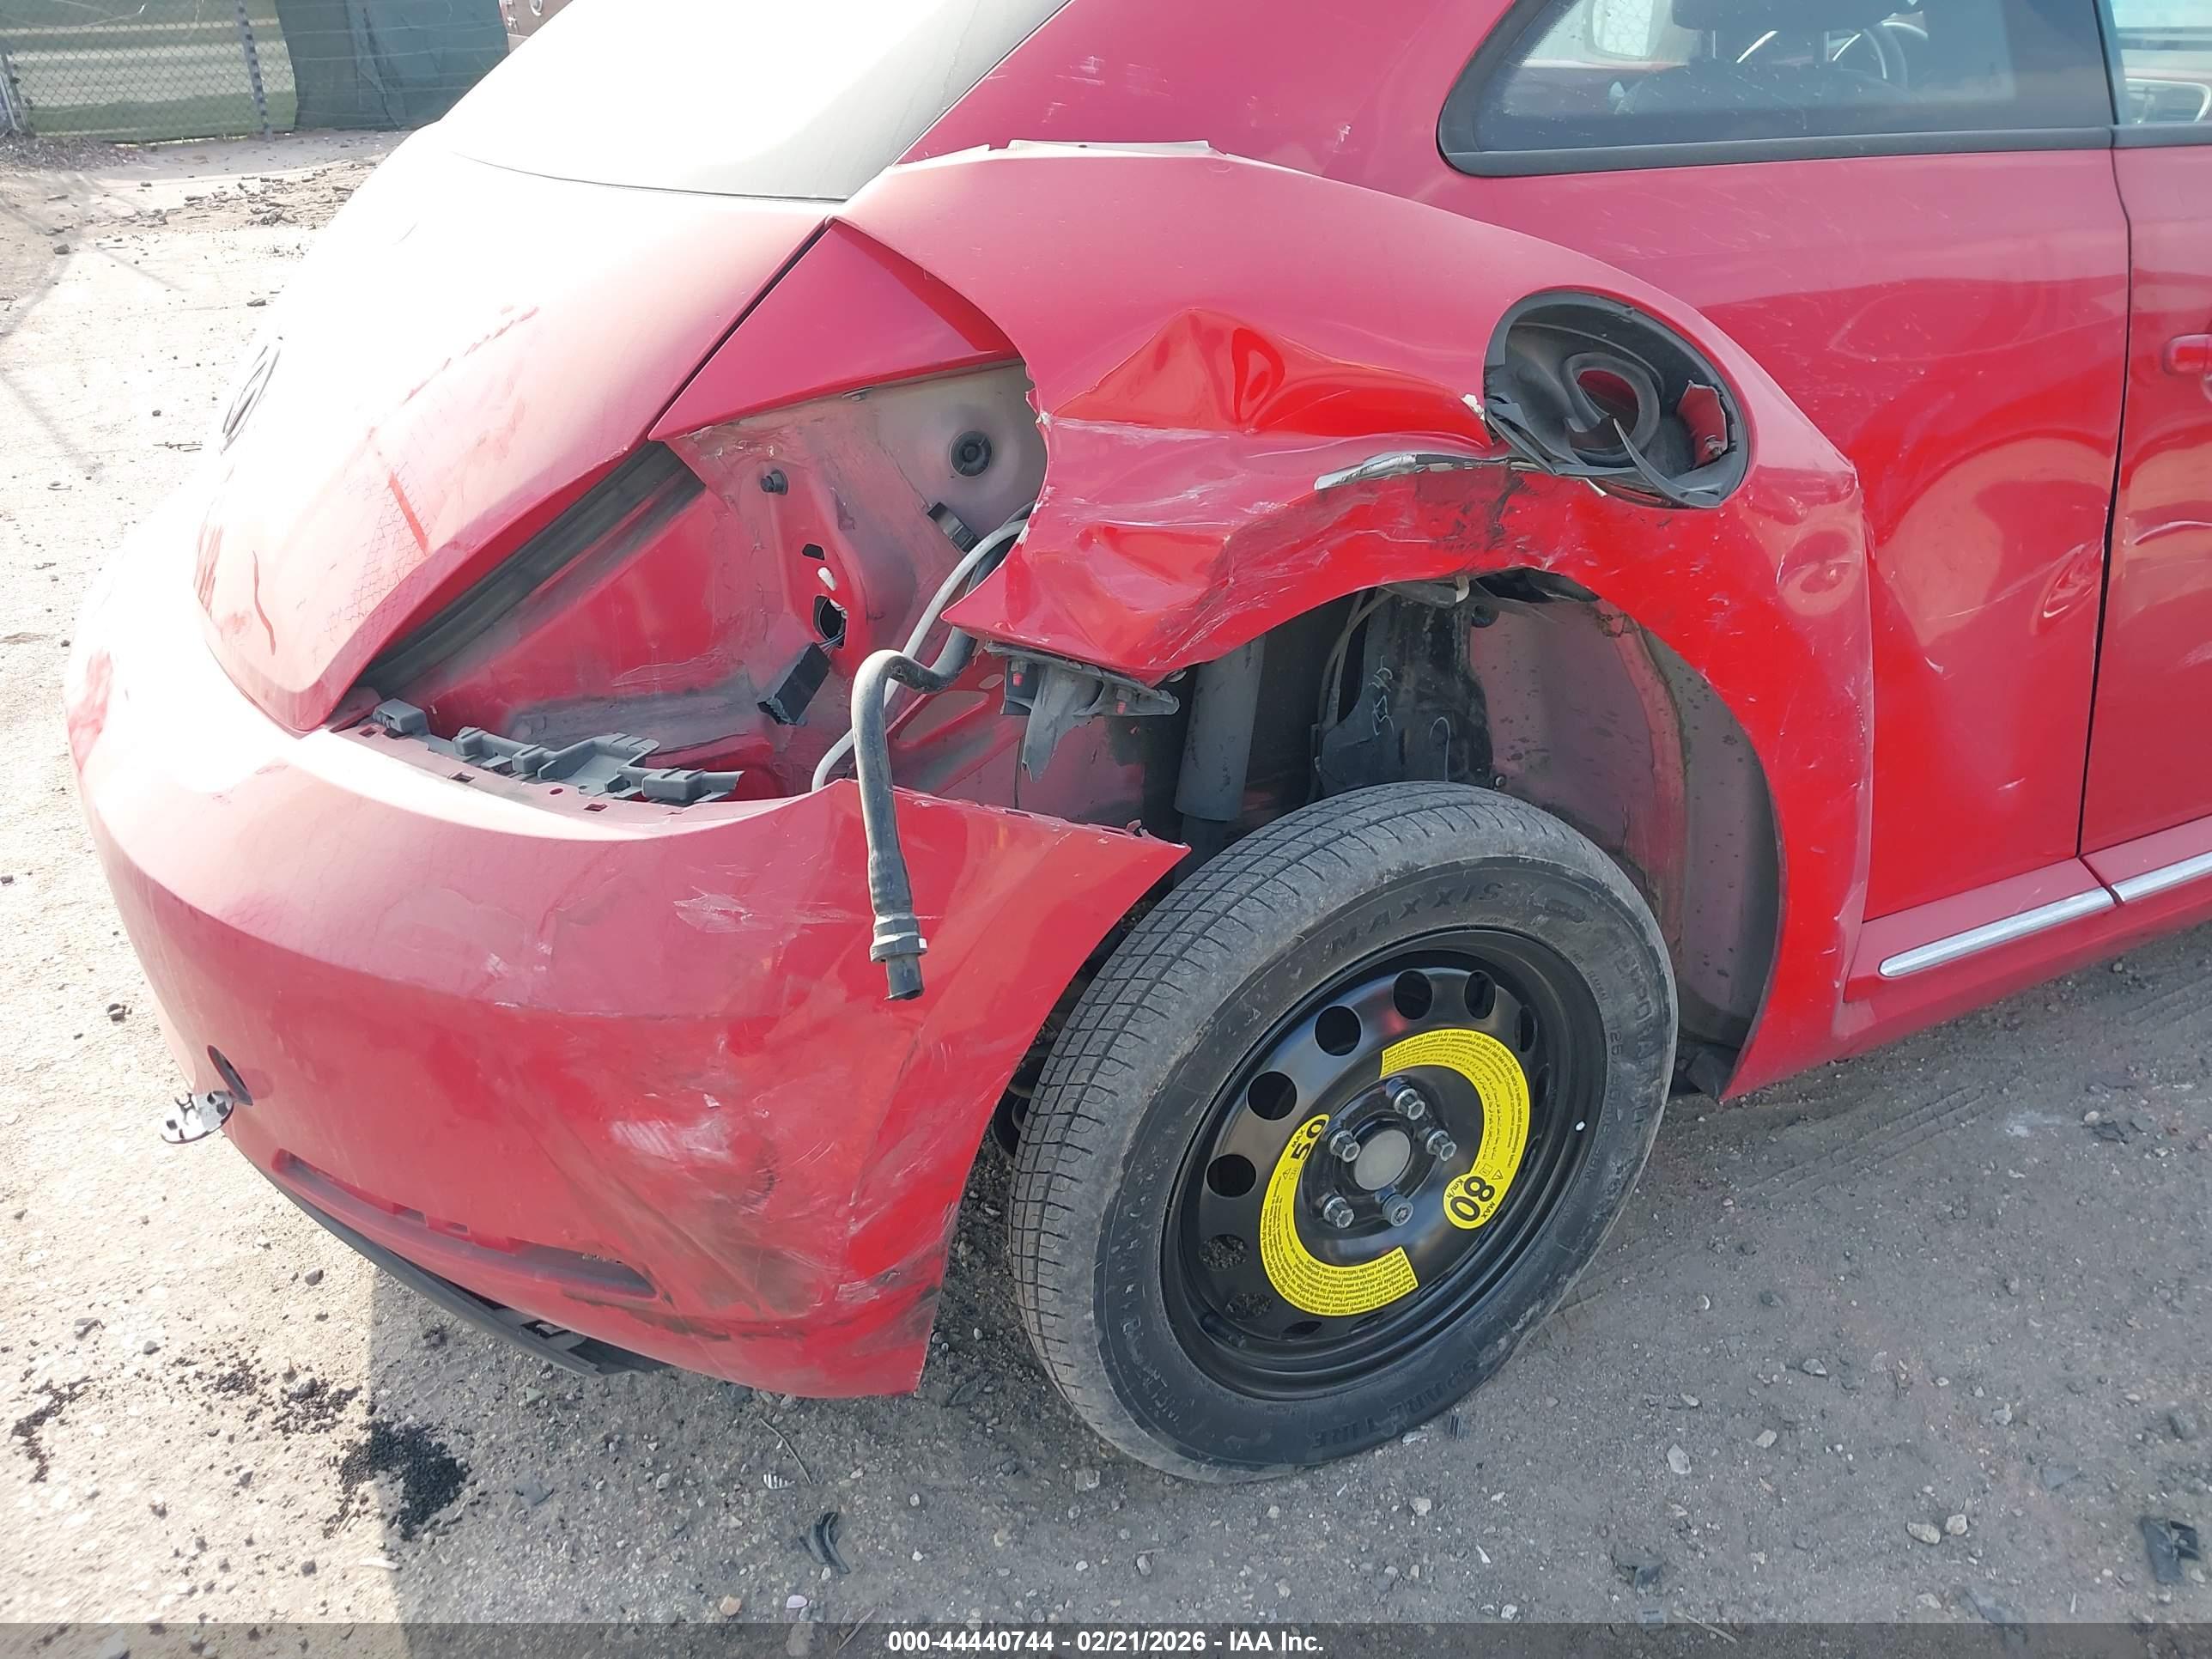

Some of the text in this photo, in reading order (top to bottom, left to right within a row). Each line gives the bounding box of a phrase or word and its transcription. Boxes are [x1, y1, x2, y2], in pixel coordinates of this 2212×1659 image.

[1331, 883, 1504, 953] MAXXIS
[1291, 1128, 1306, 1149] MAX
[1291, 1119, 1327, 1160] 50
[1450, 1176, 1496, 1222] 80
[1481, 1201, 1496, 1219] MAX
